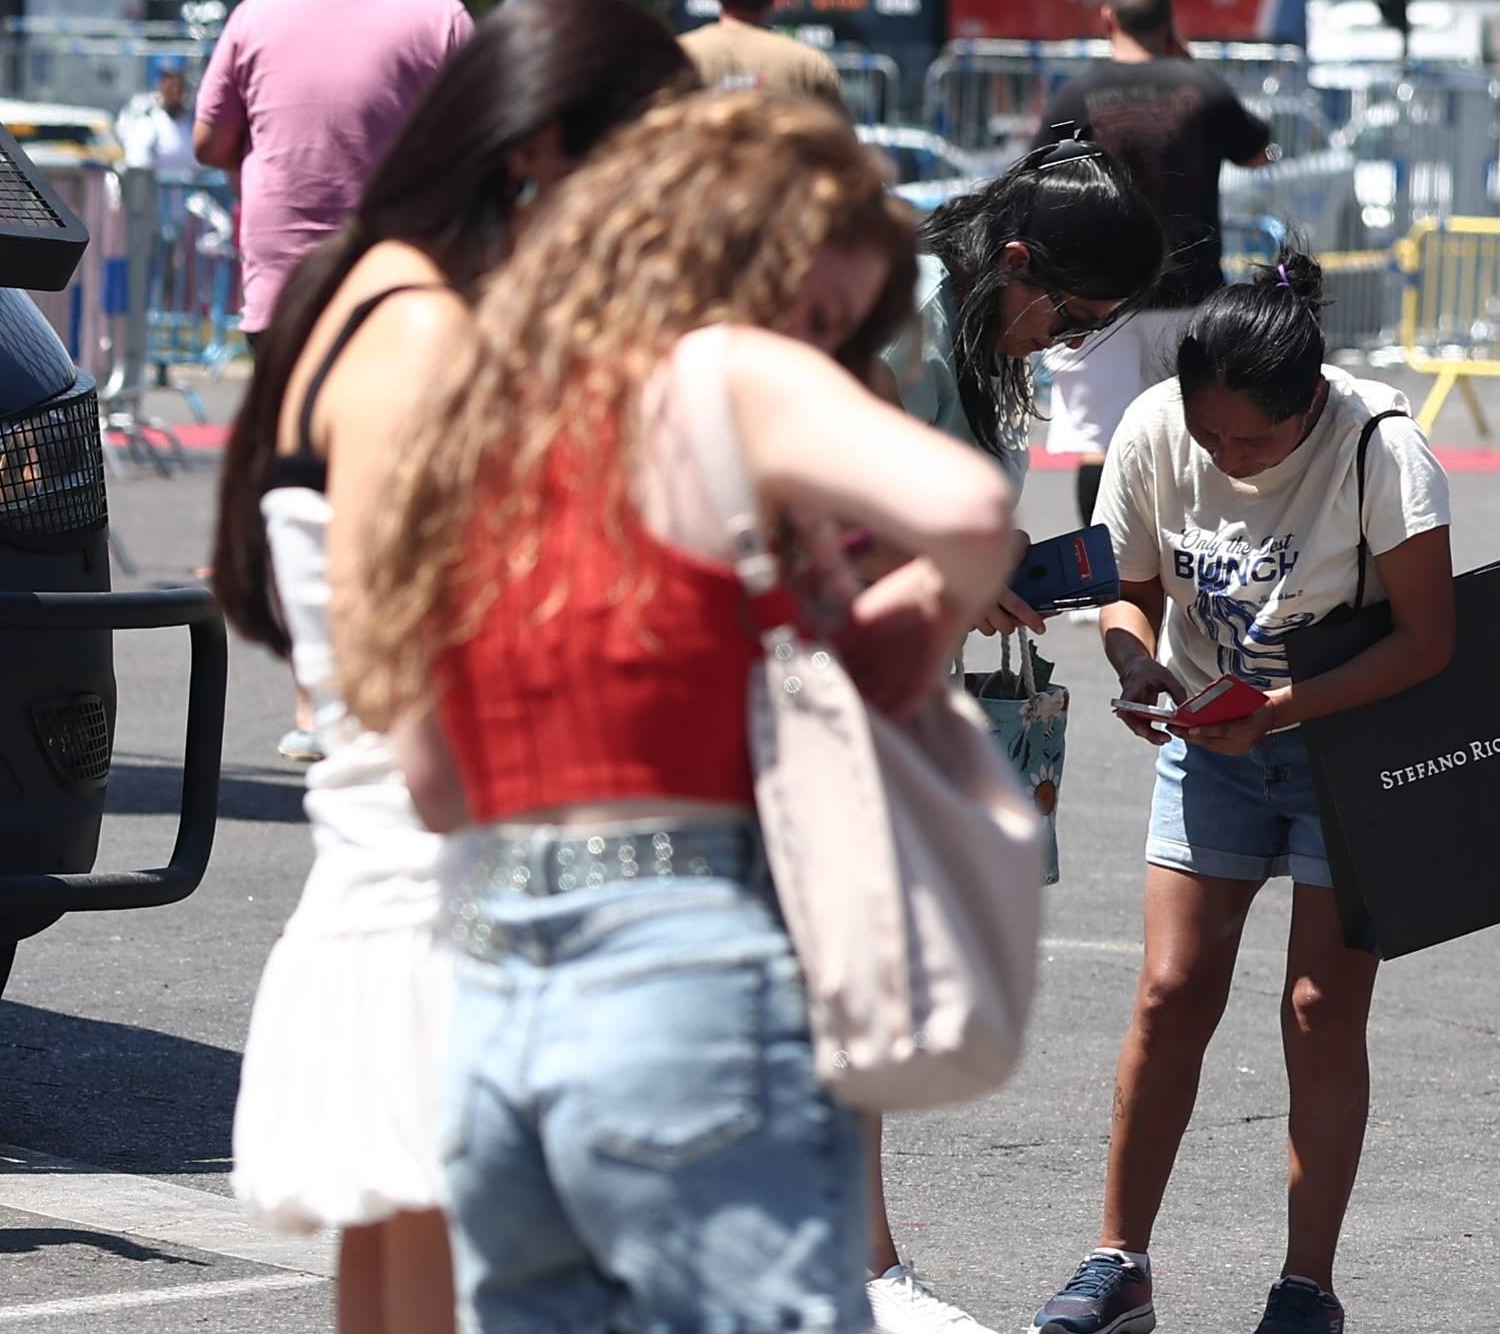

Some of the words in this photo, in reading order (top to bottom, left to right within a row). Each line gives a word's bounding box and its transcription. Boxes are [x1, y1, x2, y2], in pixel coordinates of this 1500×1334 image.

[1181, 528, 1222, 558] Only
[1227, 536, 1250, 555] the
[1174, 550, 1299, 587] BUNCH
